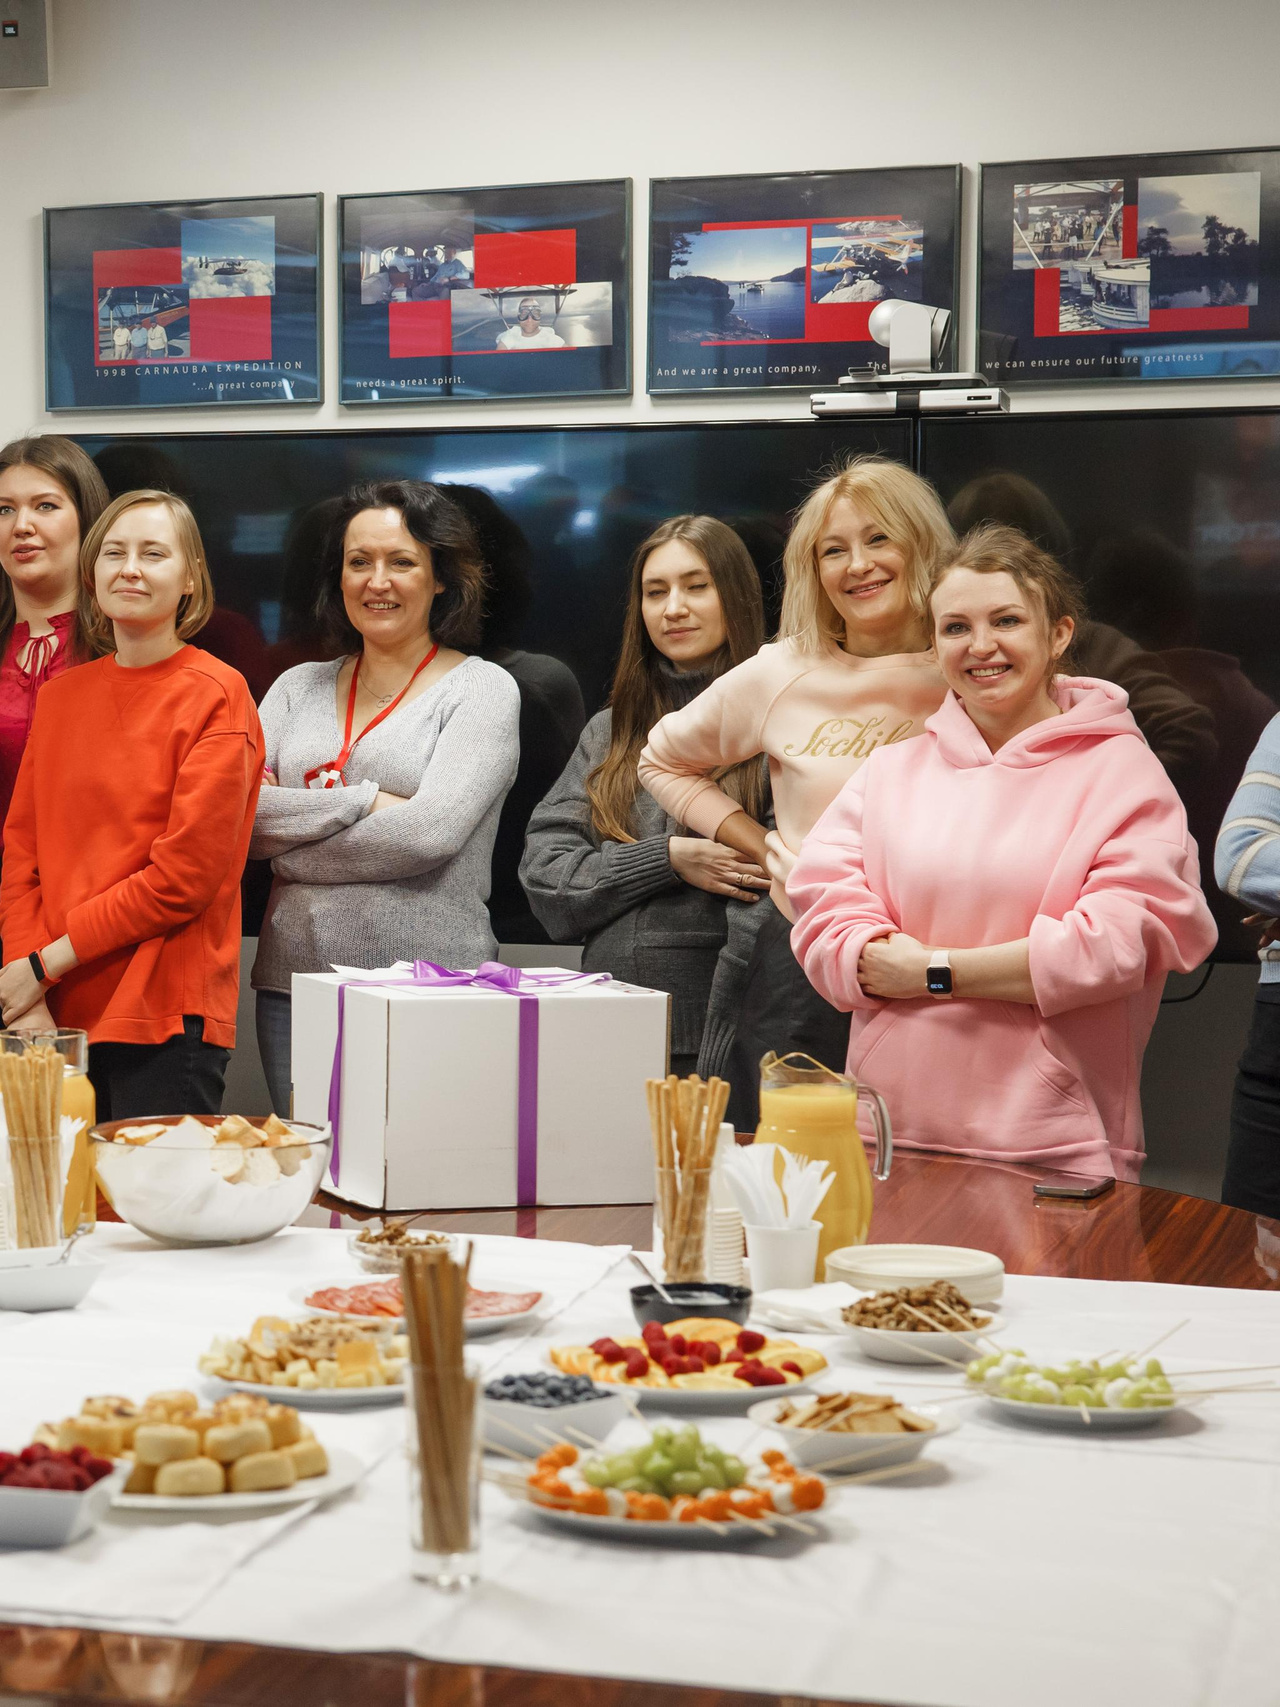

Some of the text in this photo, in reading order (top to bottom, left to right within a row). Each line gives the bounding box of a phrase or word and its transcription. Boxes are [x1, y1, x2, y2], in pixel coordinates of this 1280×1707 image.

[985, 352, 1205, 369] we can ensure our future greatness
[95, 361, 303, 377] 1998 CARNAUBA EXPEDITION
[656, 367, 678, 376] And
[682, 368, 697, 376] we
[701, 367, 718, 375] are
[733, 365, 763, 377] great
[767, 364, 821, 375] company.
[218, 381, 246, 392] great
[250, 379, 295, 390] compay
[356, 379, 386, 388] needs
[400, 378, 428, 388] great
[432, 375, 466, 387] spirit.
